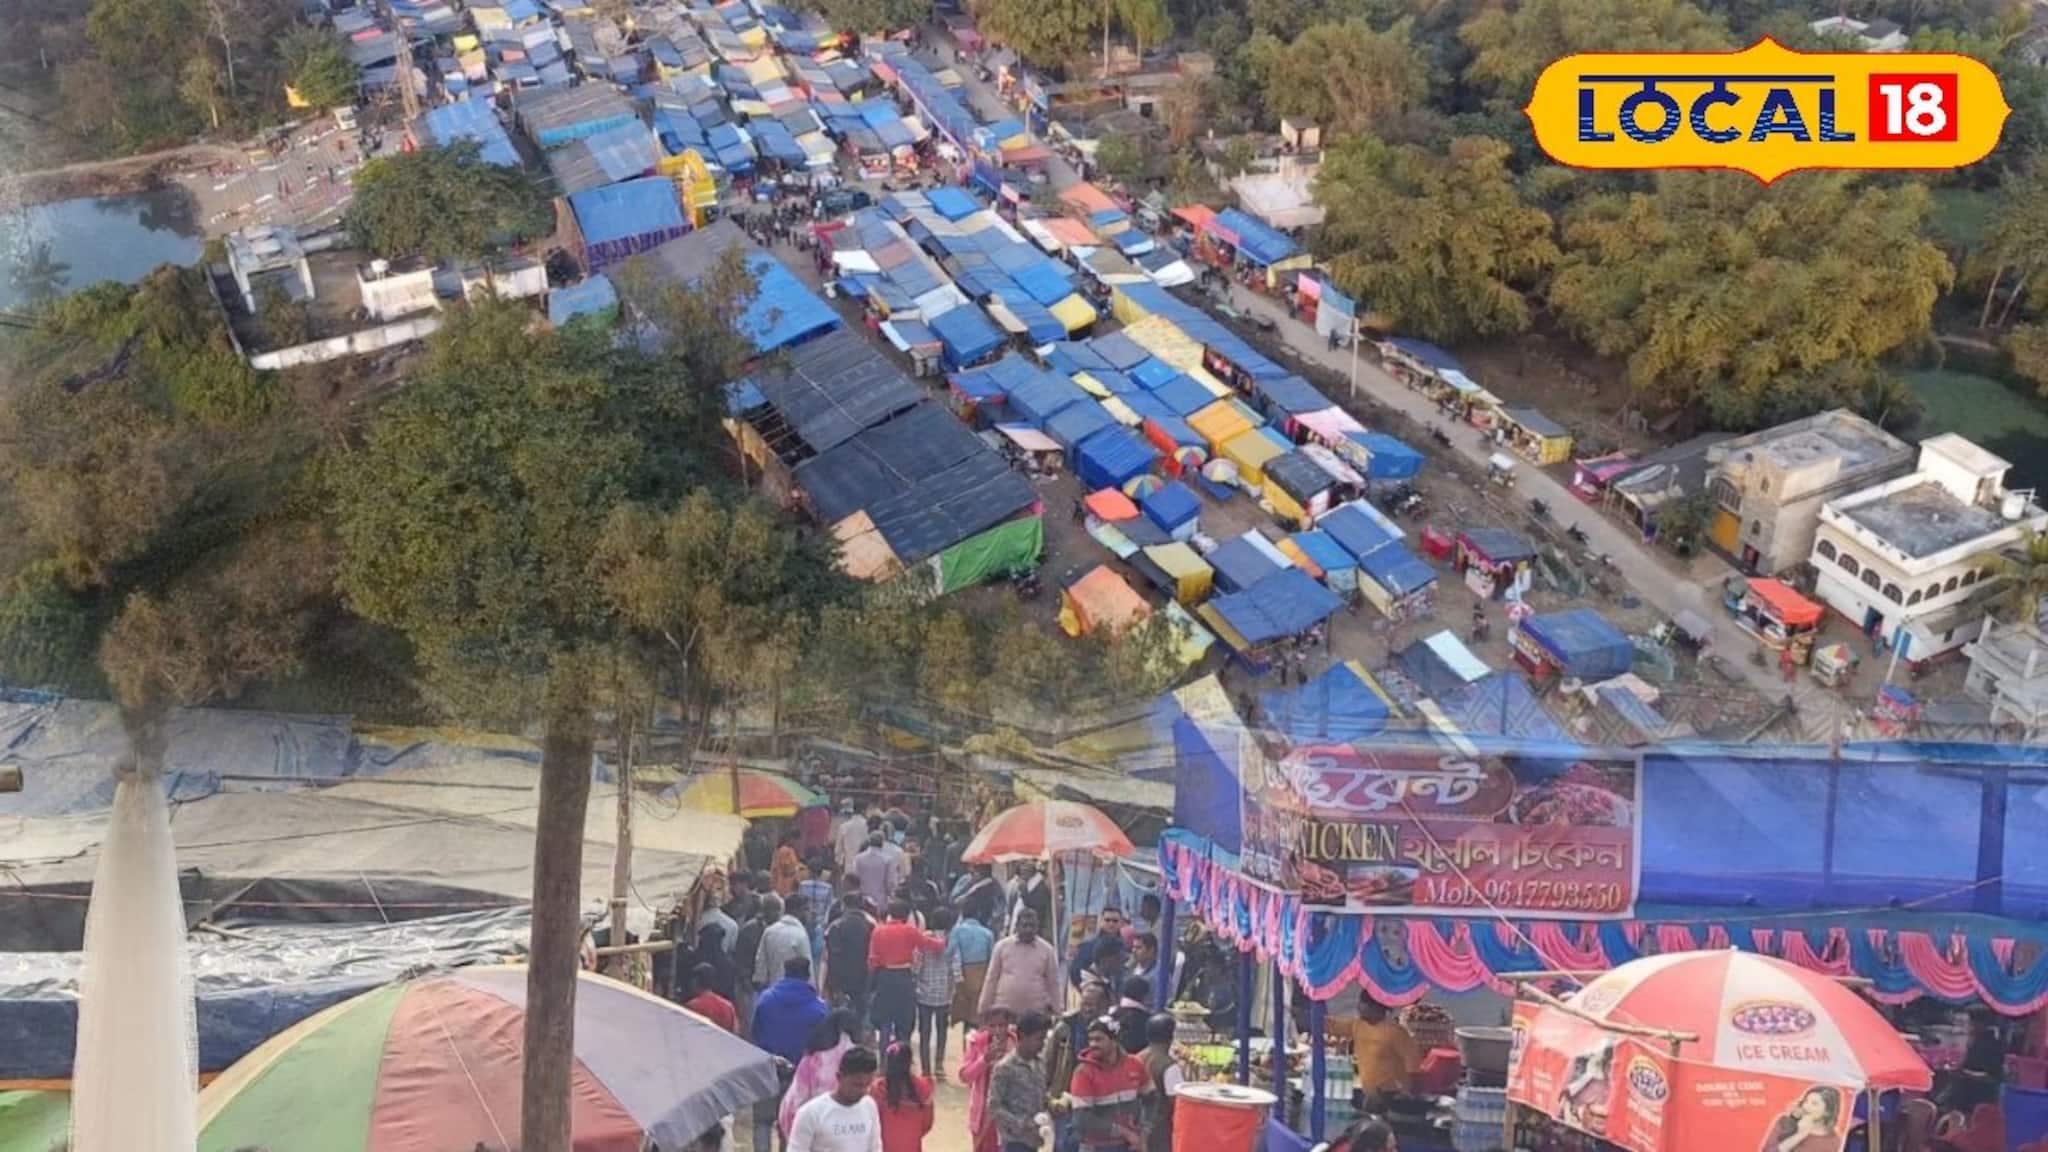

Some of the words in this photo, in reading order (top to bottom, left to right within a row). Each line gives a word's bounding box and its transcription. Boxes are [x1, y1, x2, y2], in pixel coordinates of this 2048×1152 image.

[1510, 832, 1623, 870] চিকেন
[1736, 1044, 1763, 1061] ICE
[1769, 1044, 1831, 1063] CREAM
